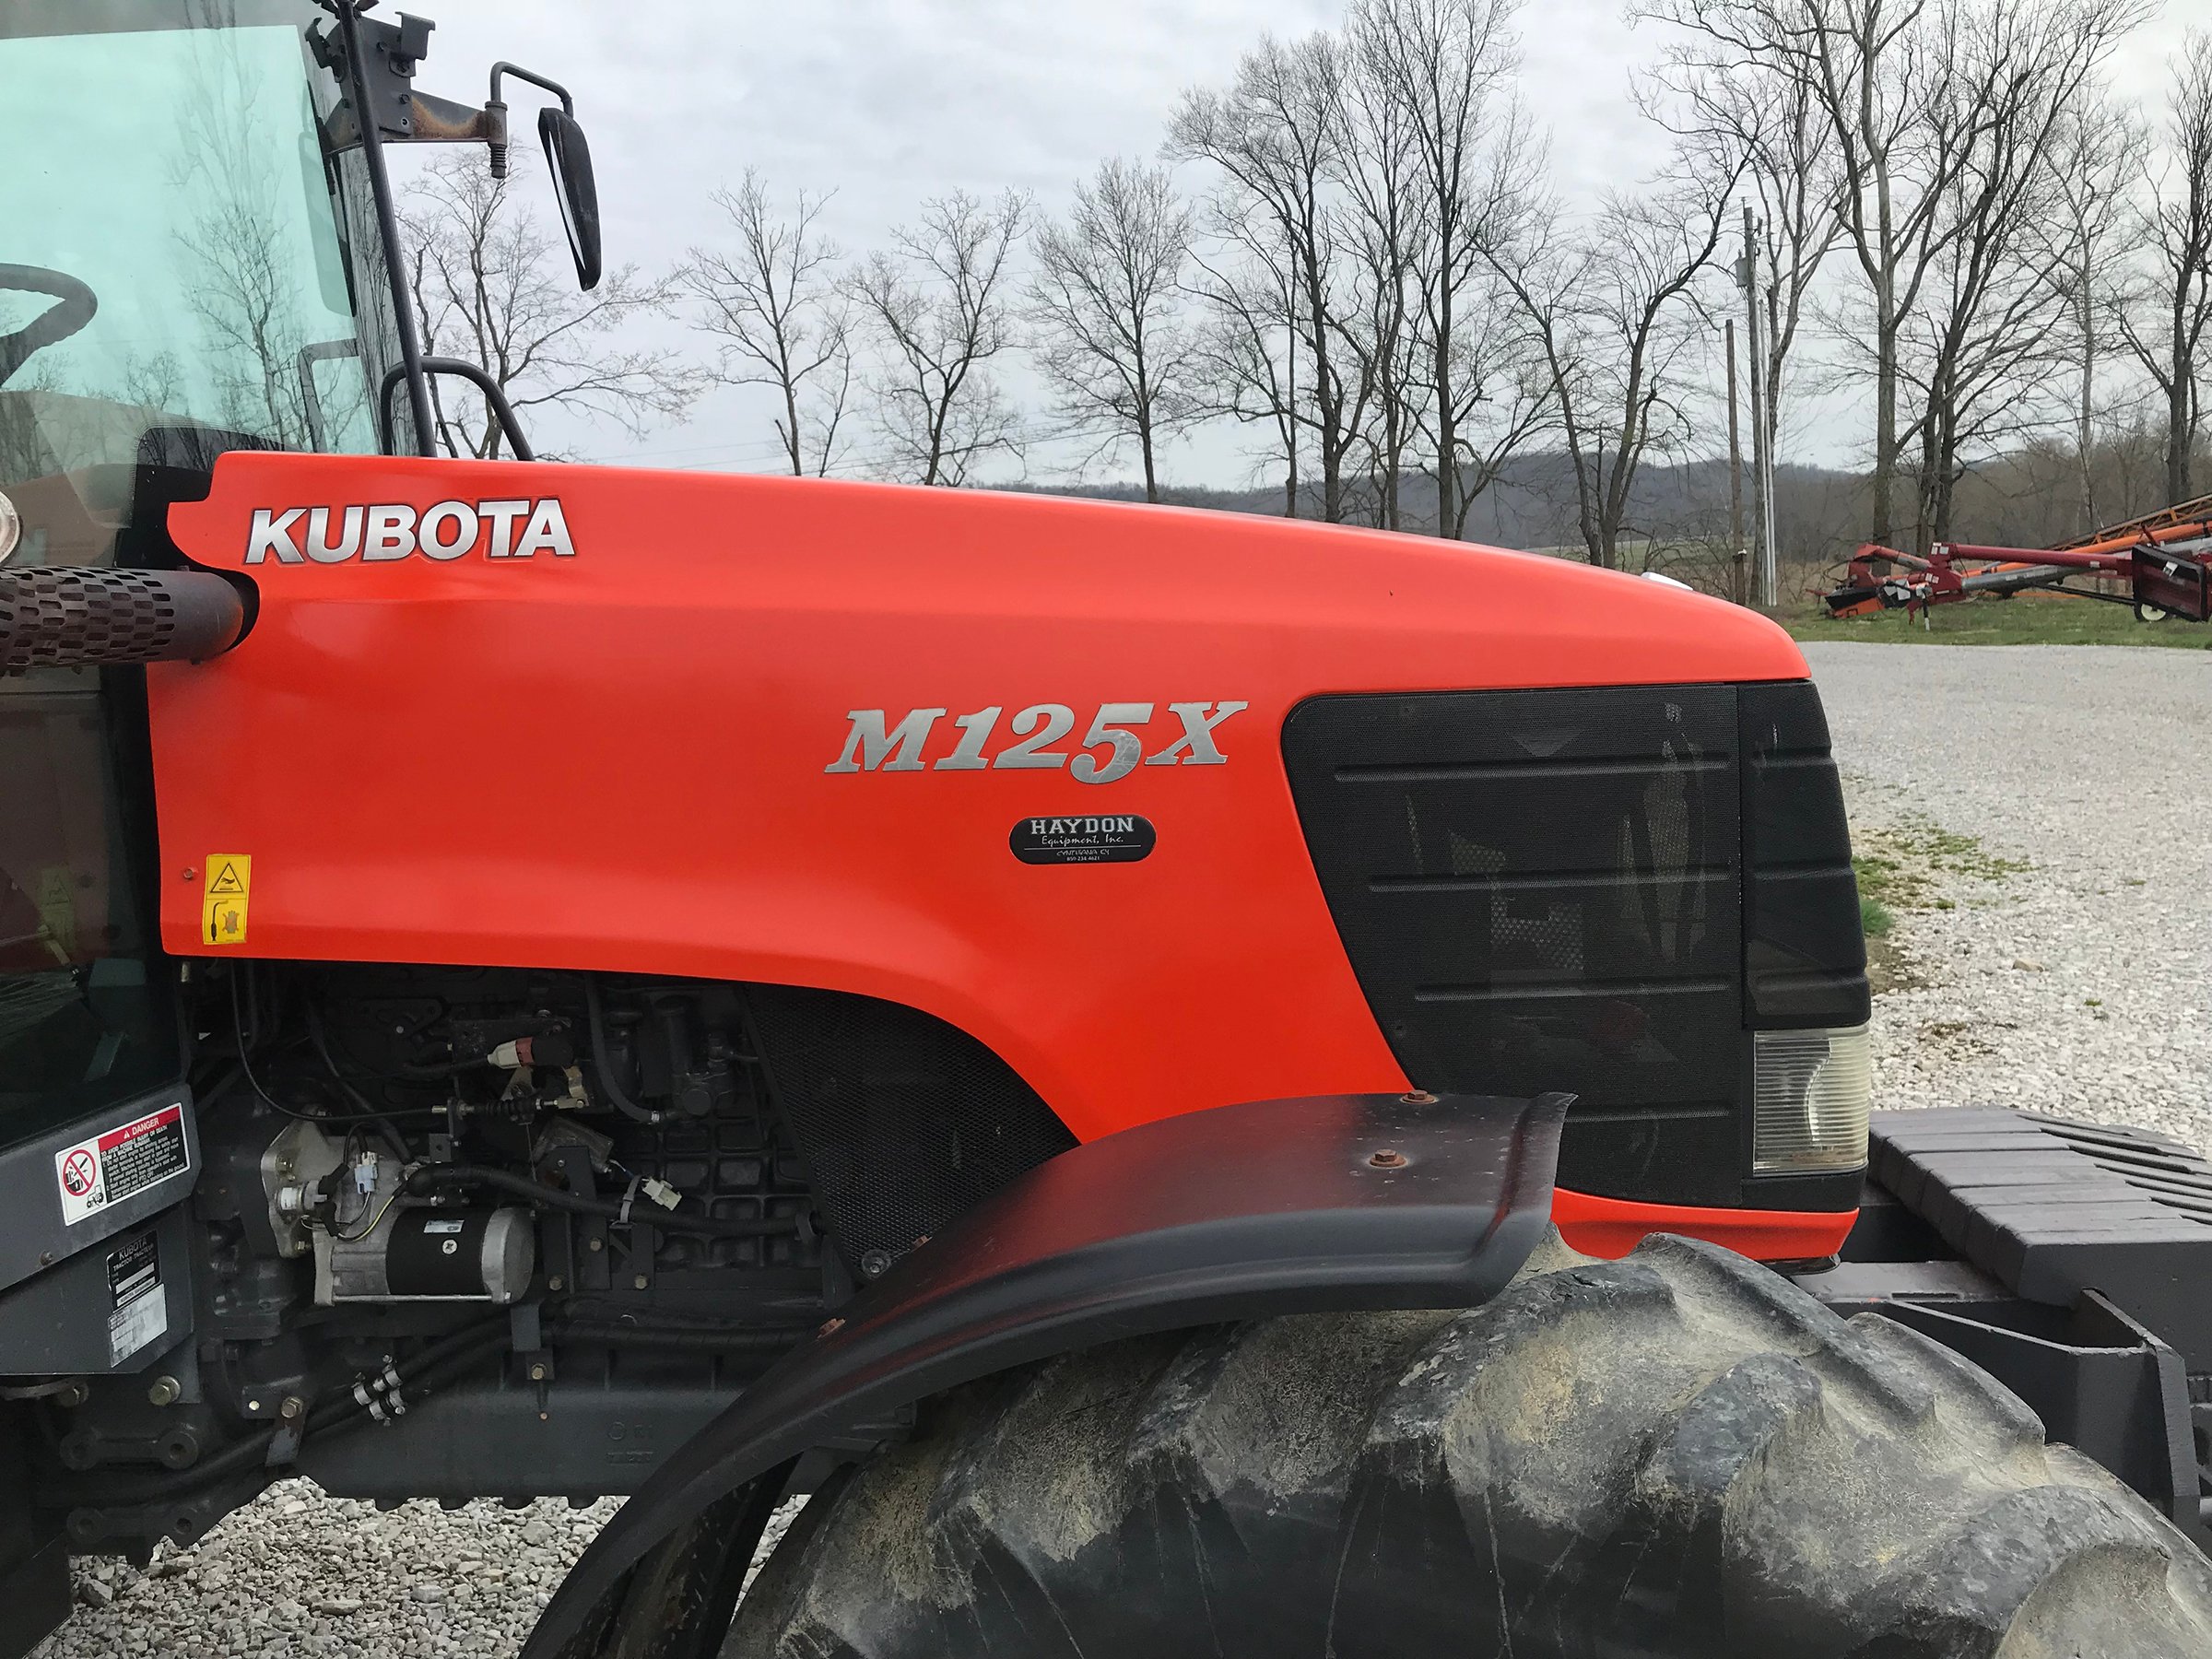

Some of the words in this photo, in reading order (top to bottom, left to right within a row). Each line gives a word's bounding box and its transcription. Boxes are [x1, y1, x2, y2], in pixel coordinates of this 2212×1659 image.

[244, 499, 576, 564] KUBOTA
[824, 700, 1249, 784] M125X
[1031, 818, 1135, 834] HAYDON
[1105, 833, 1124, 843] Inc.
[132, 1118, 159, 1135] DANGER
[119, 1238, 147, 1261] KUBOTA
